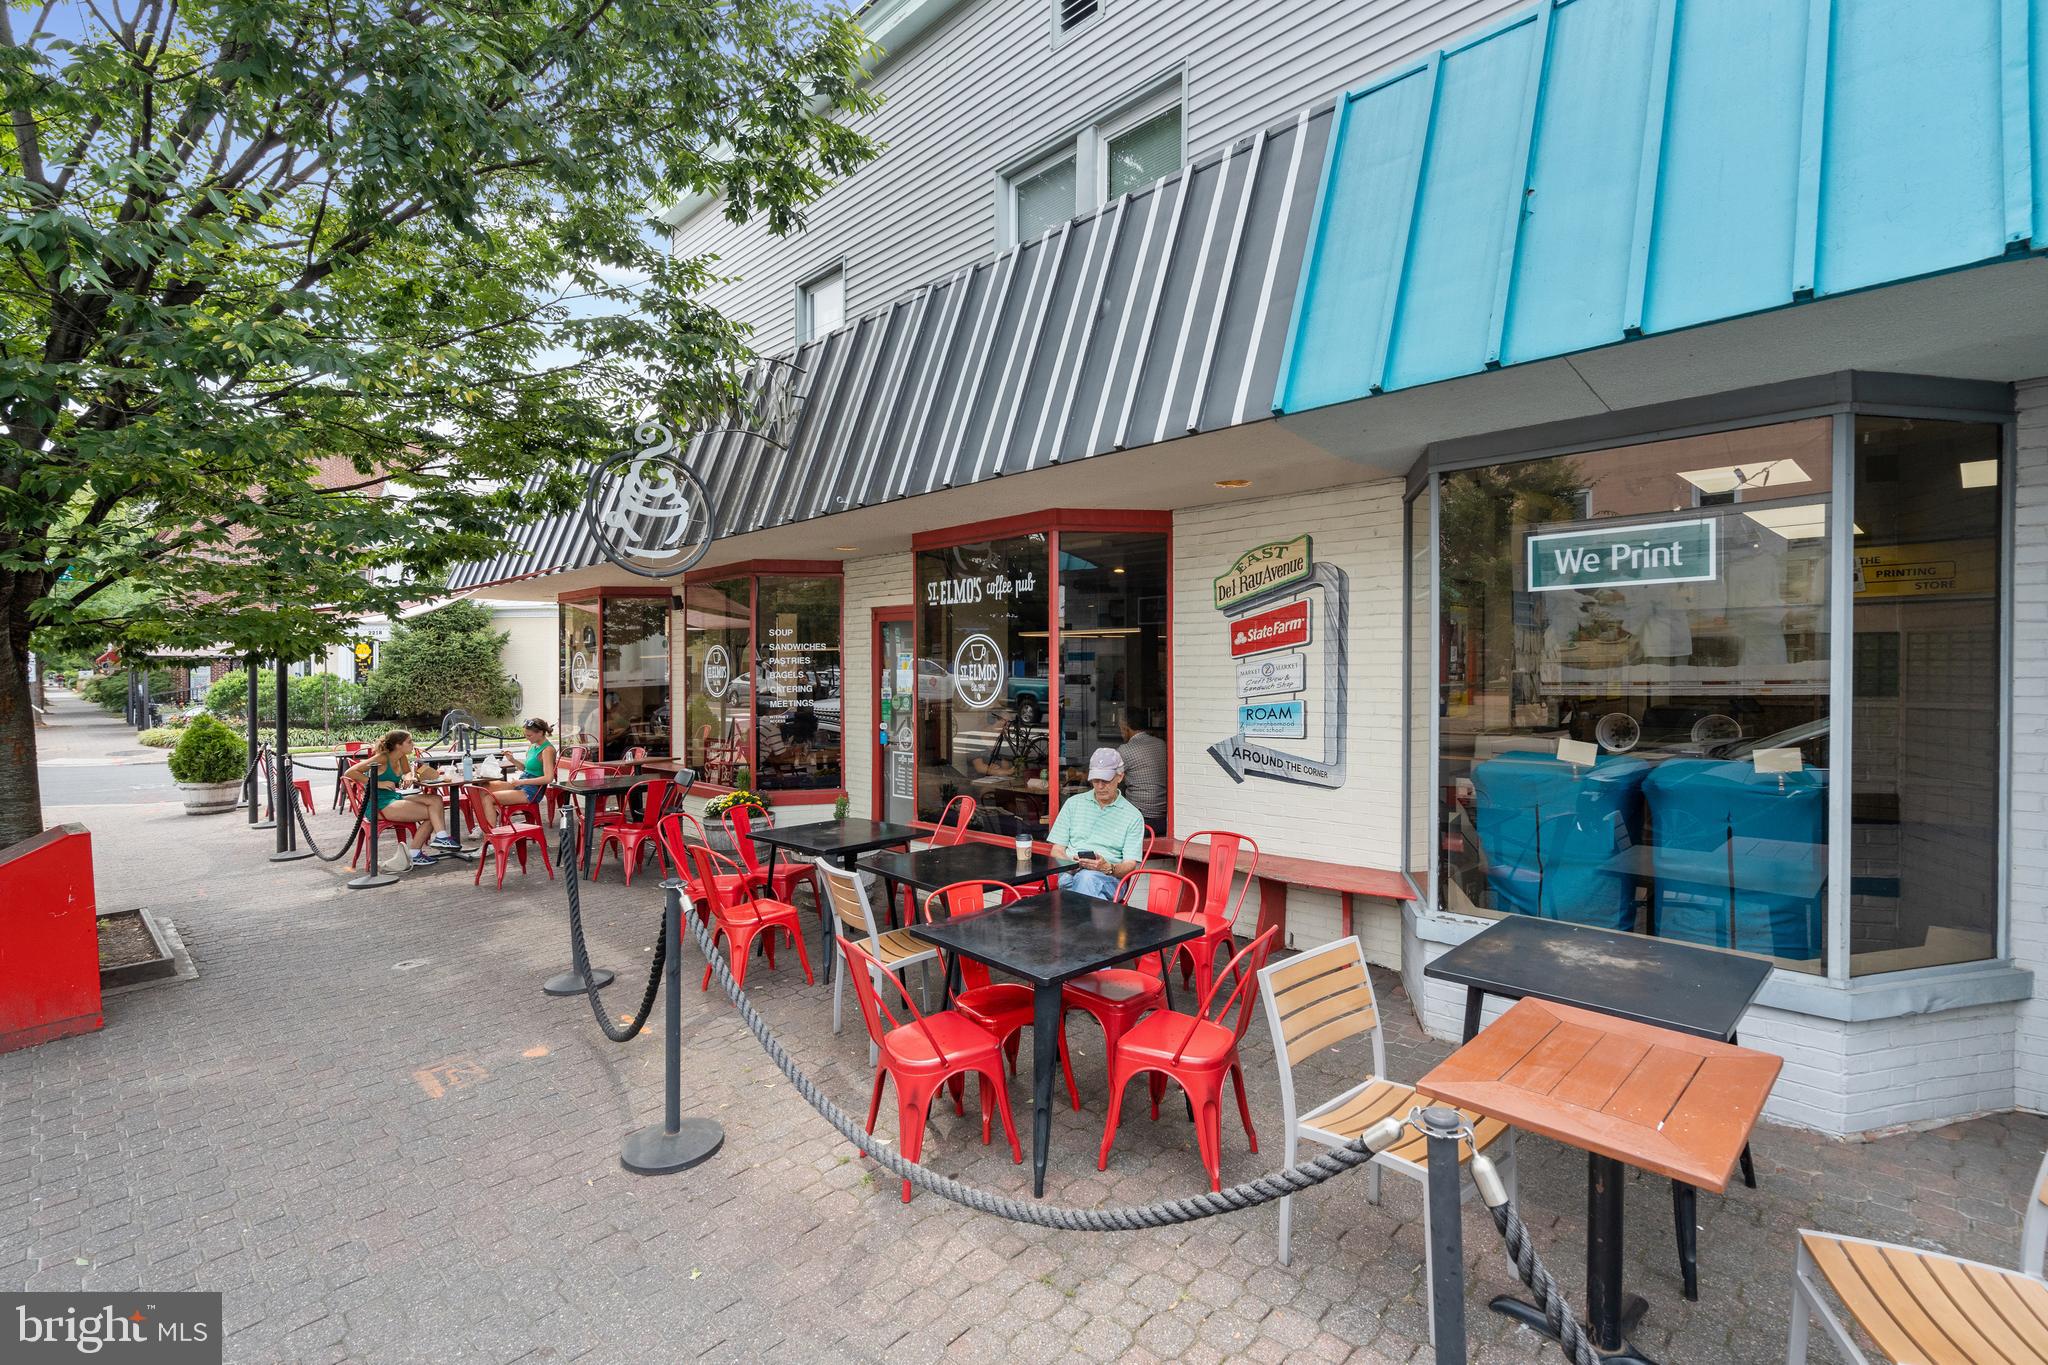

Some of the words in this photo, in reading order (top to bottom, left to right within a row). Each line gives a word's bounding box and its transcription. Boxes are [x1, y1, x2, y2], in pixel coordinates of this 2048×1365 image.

[1234, 546, 1289, 574] EAST
[1554, 547, 1600, 575] We
[1611, 541, 1683, 571] Print
[1859, 556, 1881, 565] THE
[1876, 567, 1937, 578] PRINTING
[1218, 578, 1236, 602] Del
[1239, 571, 1262, 594] Ray
[1262, 557, 1304, 584] Avenue
[927, 581, 939, 602] ST.
[939, 576, 982, 605] ELMO'S
[986, 574, 1013, 600] coffee
[1015, 571, 1036, 598] pub
[1914, 580, 1957, 590] STORE
[768, 628, 793, 637] SOUP
[768, 642, 827, 651] SANDWICHES
[769, 656, 811, 665] PASTRIES
[769, 670, 804, 679] BAGELS
[969, 663, 998, 681] ELMO'S
[770, 685, 813, 694] CATERING
[769, 699, 815, 708] MEETINGS
[1246, 705, 1293, 721] ROAM
[1231, 747, 1284, 769] AROUND
[1285, 761, 1302, 773] THE
[1303, 765, 1328, 778] CORNER
